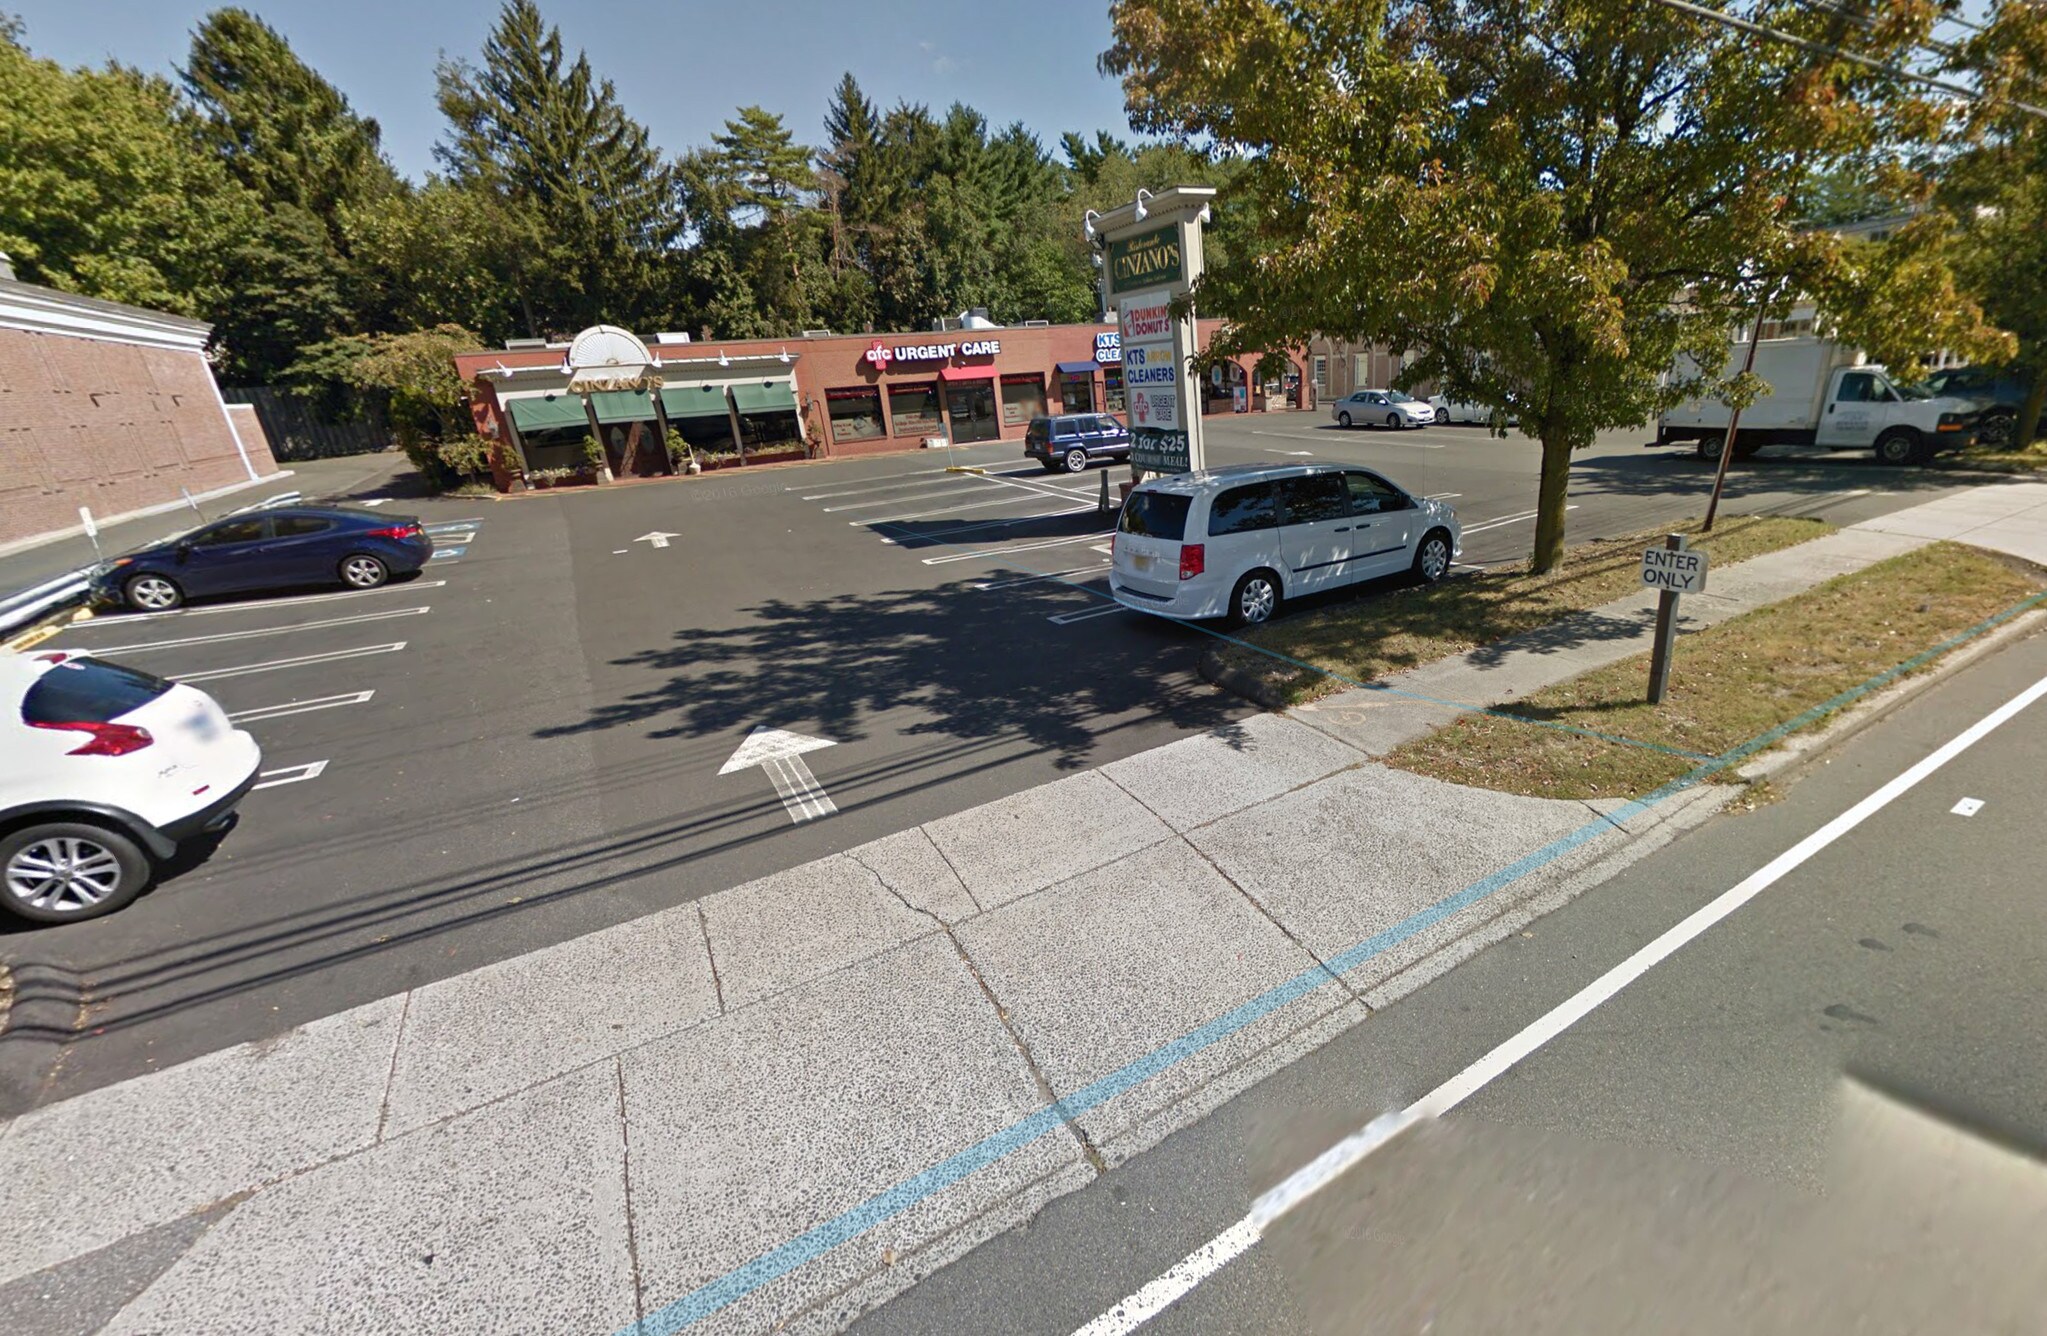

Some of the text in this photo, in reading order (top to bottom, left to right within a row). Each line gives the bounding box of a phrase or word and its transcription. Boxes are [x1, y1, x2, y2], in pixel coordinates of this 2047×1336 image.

[1114, 243, 1179, 279] CINZANO'S
[1097, 333, 1121, 347] KTS
[866, 340, 1001, 361] afc URGENT CARE
[1126, 348, 1146, 366] KTS
[1127, 366, 1175, 384] CLEANERS
[1150, 394, 1176, 408] URGENT
[1155, 408, 1172, 421] CARE
[1130, 432, 1185, 454] 2 for $25
[1163, 456, 1188, 467] MEAL!
[1645, 550, 1698, 571] ENTER
[1643, 568, 1695, 589] ONLY
